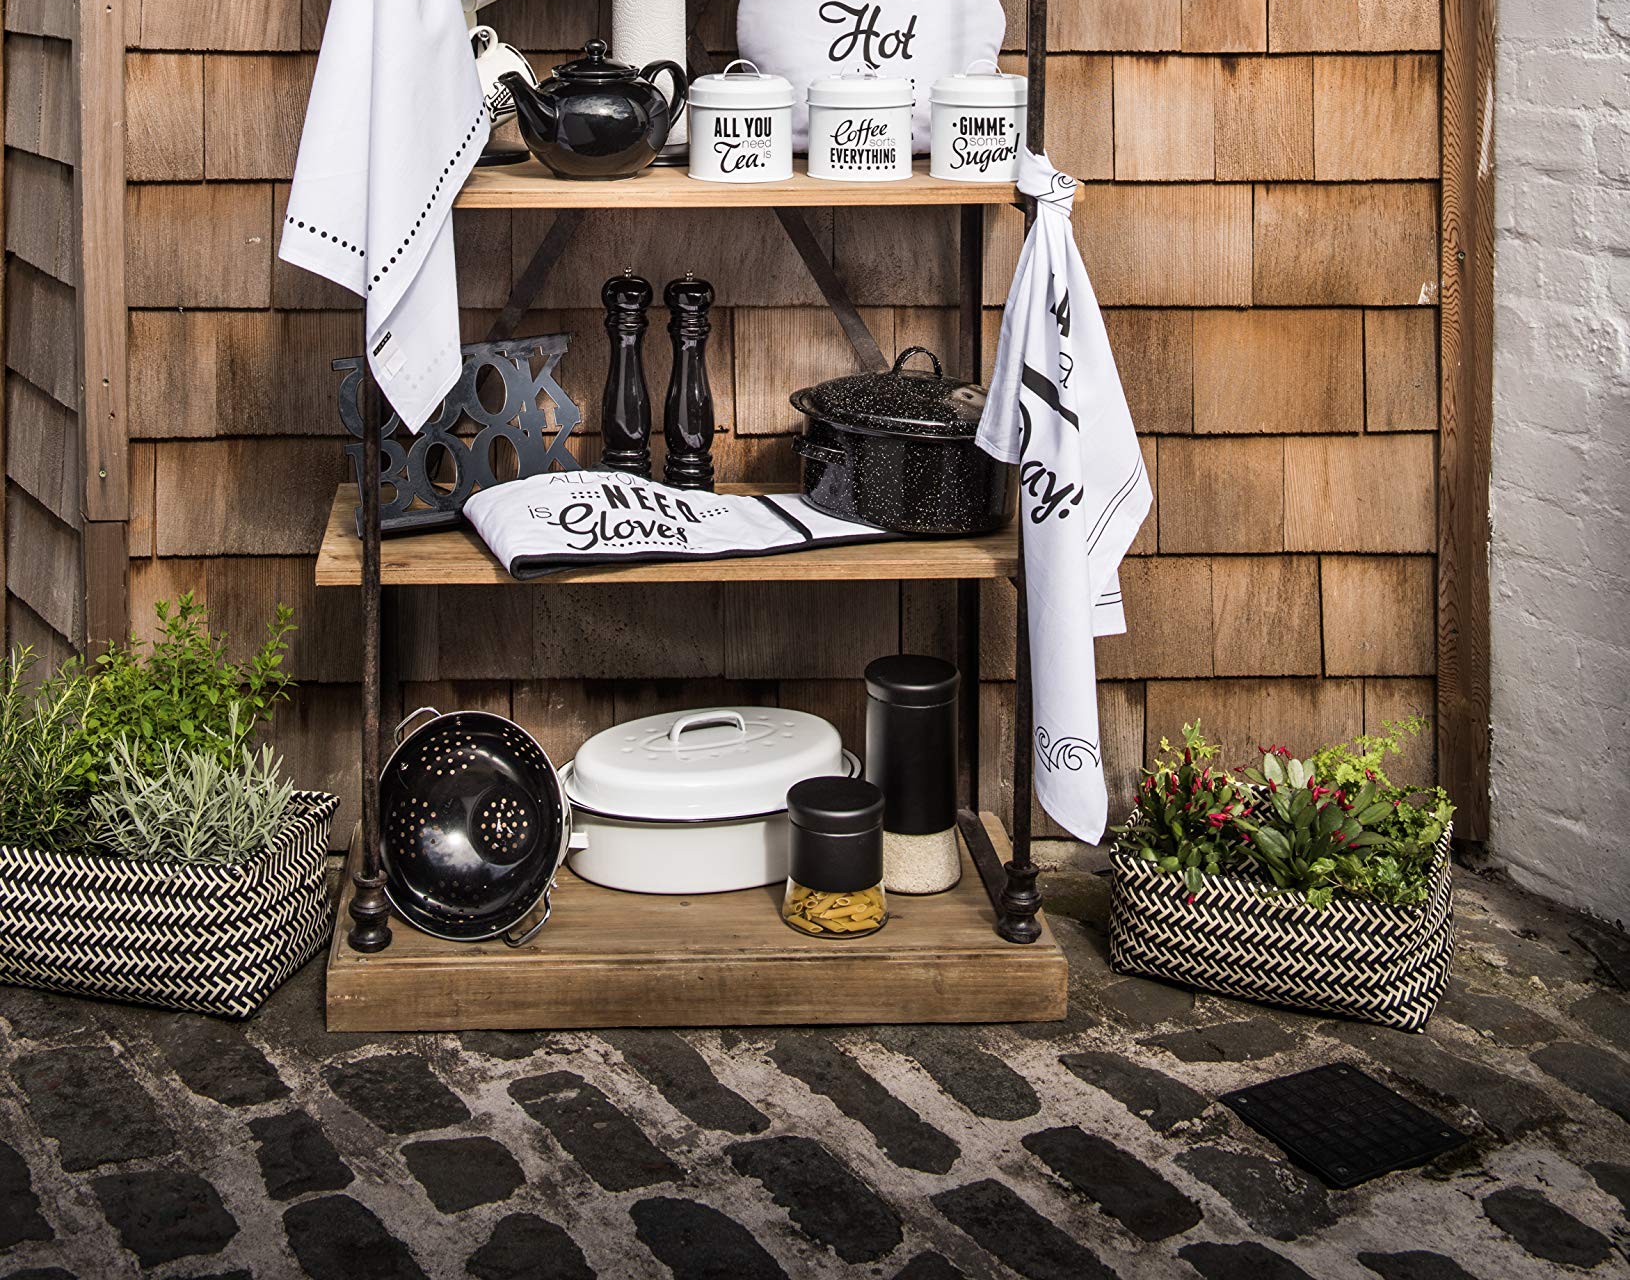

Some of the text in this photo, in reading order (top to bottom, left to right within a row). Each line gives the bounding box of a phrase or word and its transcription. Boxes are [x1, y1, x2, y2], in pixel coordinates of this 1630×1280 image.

[818, 1, 918, 69] Hot
[714, 117, 772, 138] ALL YOU
[830, 118, 888, 147] Coffee
[960, 116, 1006, 136] GIMME
[742, 137, 772, 149] need
[869, 137, 896, 147] sorts
[969, 136, 1006, 146] some
[713, 141, 765, 173] Tea.
[763, 150, 772, 159] is
[830, 148, 896, 164] EVERYTHING
[950, 132, 1020, 173] Sugar!
[338, 348, 581, 440] COK
[550, 473, 594, 485] ALL
[527, 505, 552, 519] is
[601, 484, 702, 523] NEED
[547, 503, 688, 550] Gloves
